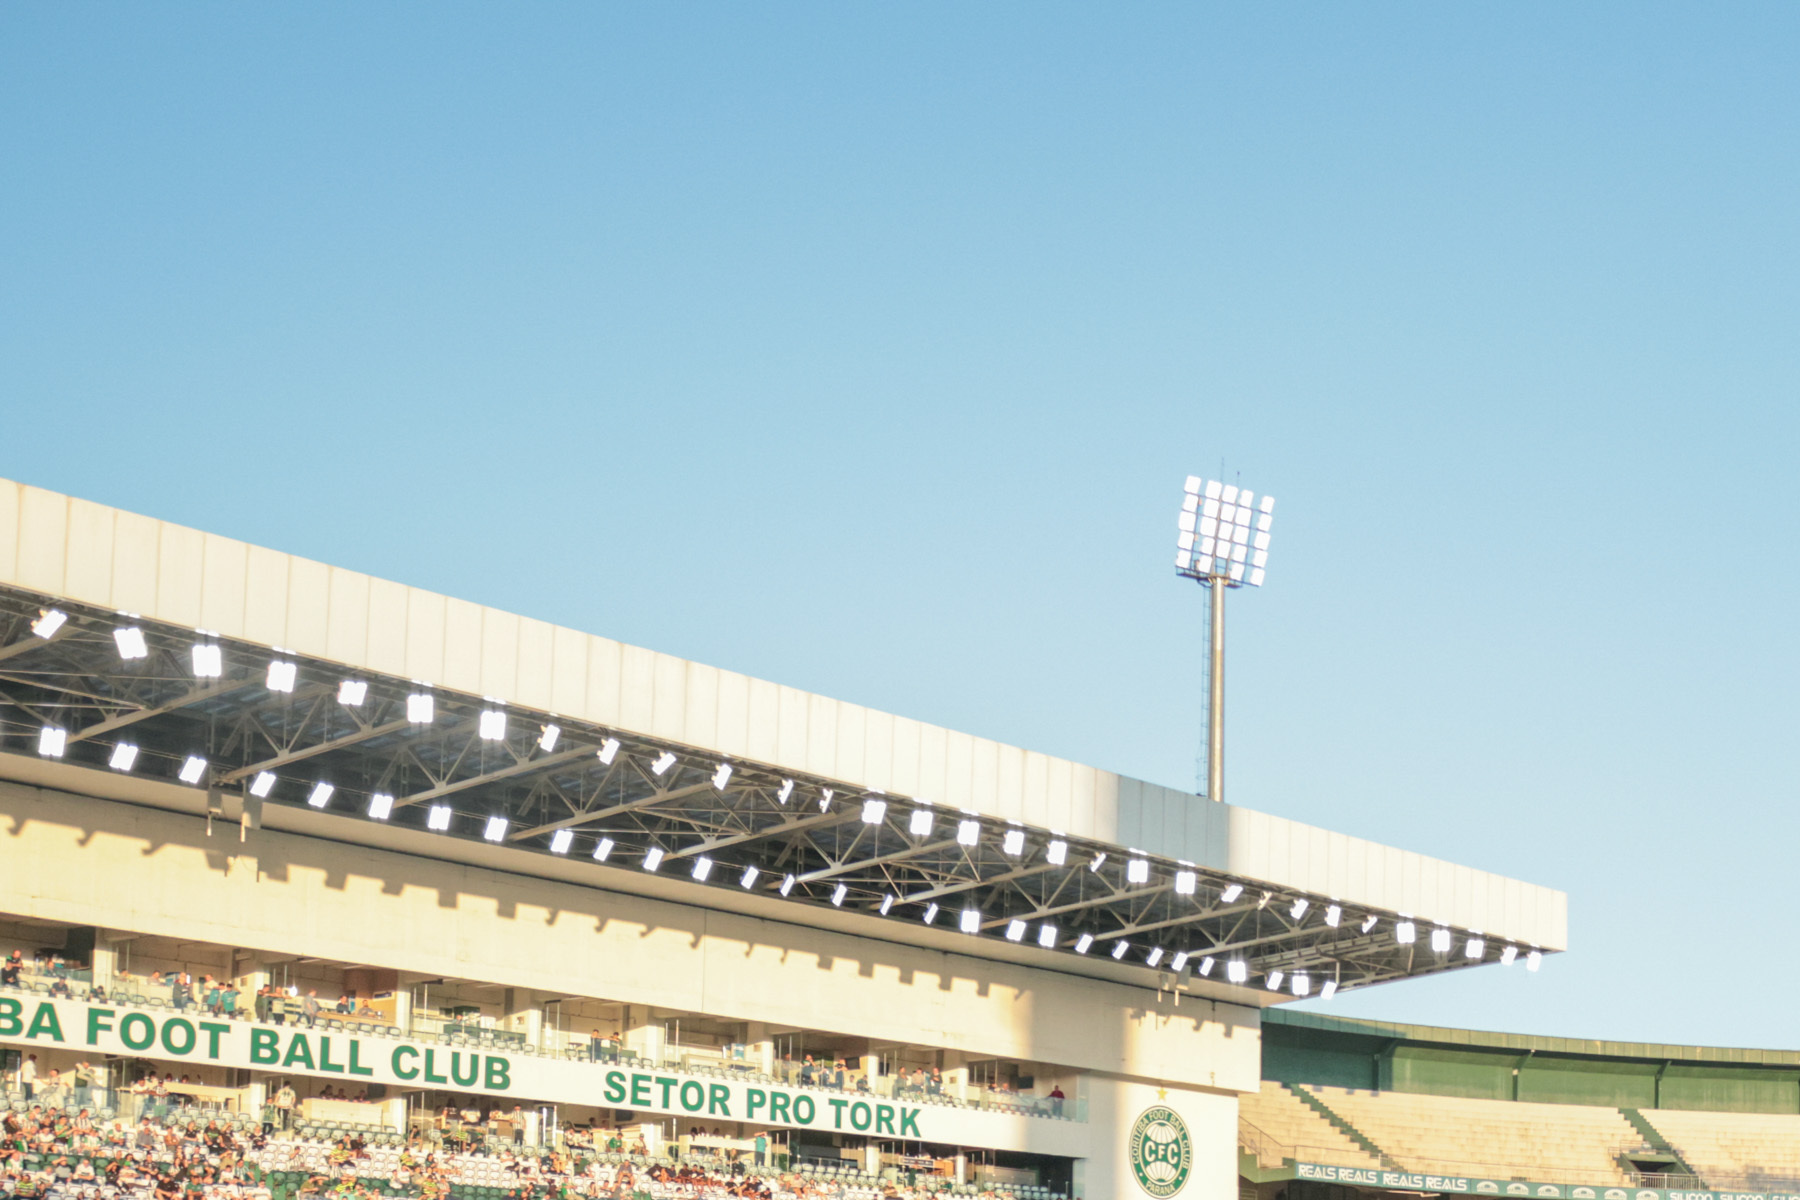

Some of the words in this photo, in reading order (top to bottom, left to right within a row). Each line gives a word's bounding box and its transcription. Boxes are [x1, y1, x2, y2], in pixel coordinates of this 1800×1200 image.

[86, 1006, 231, 1060] FOOT
[250, 1027, 374, 1077] BALL
[391, 1045, 511, 1091] CLUB
[603, 1070, 731, 1117] SETOR
[746, 1087, 816, 1125] PRO
[827, 1099, 922, 1138] TORK
[1144, 1141, 1178, 1165] CFC
[1299, 1164, 1336, 1180] REALS
[1338, 1168, 1377, 1184] REALS
[1383, 1172, 1423, 1188] REALS
[1425, 1176, 1467, 1191] REALS
